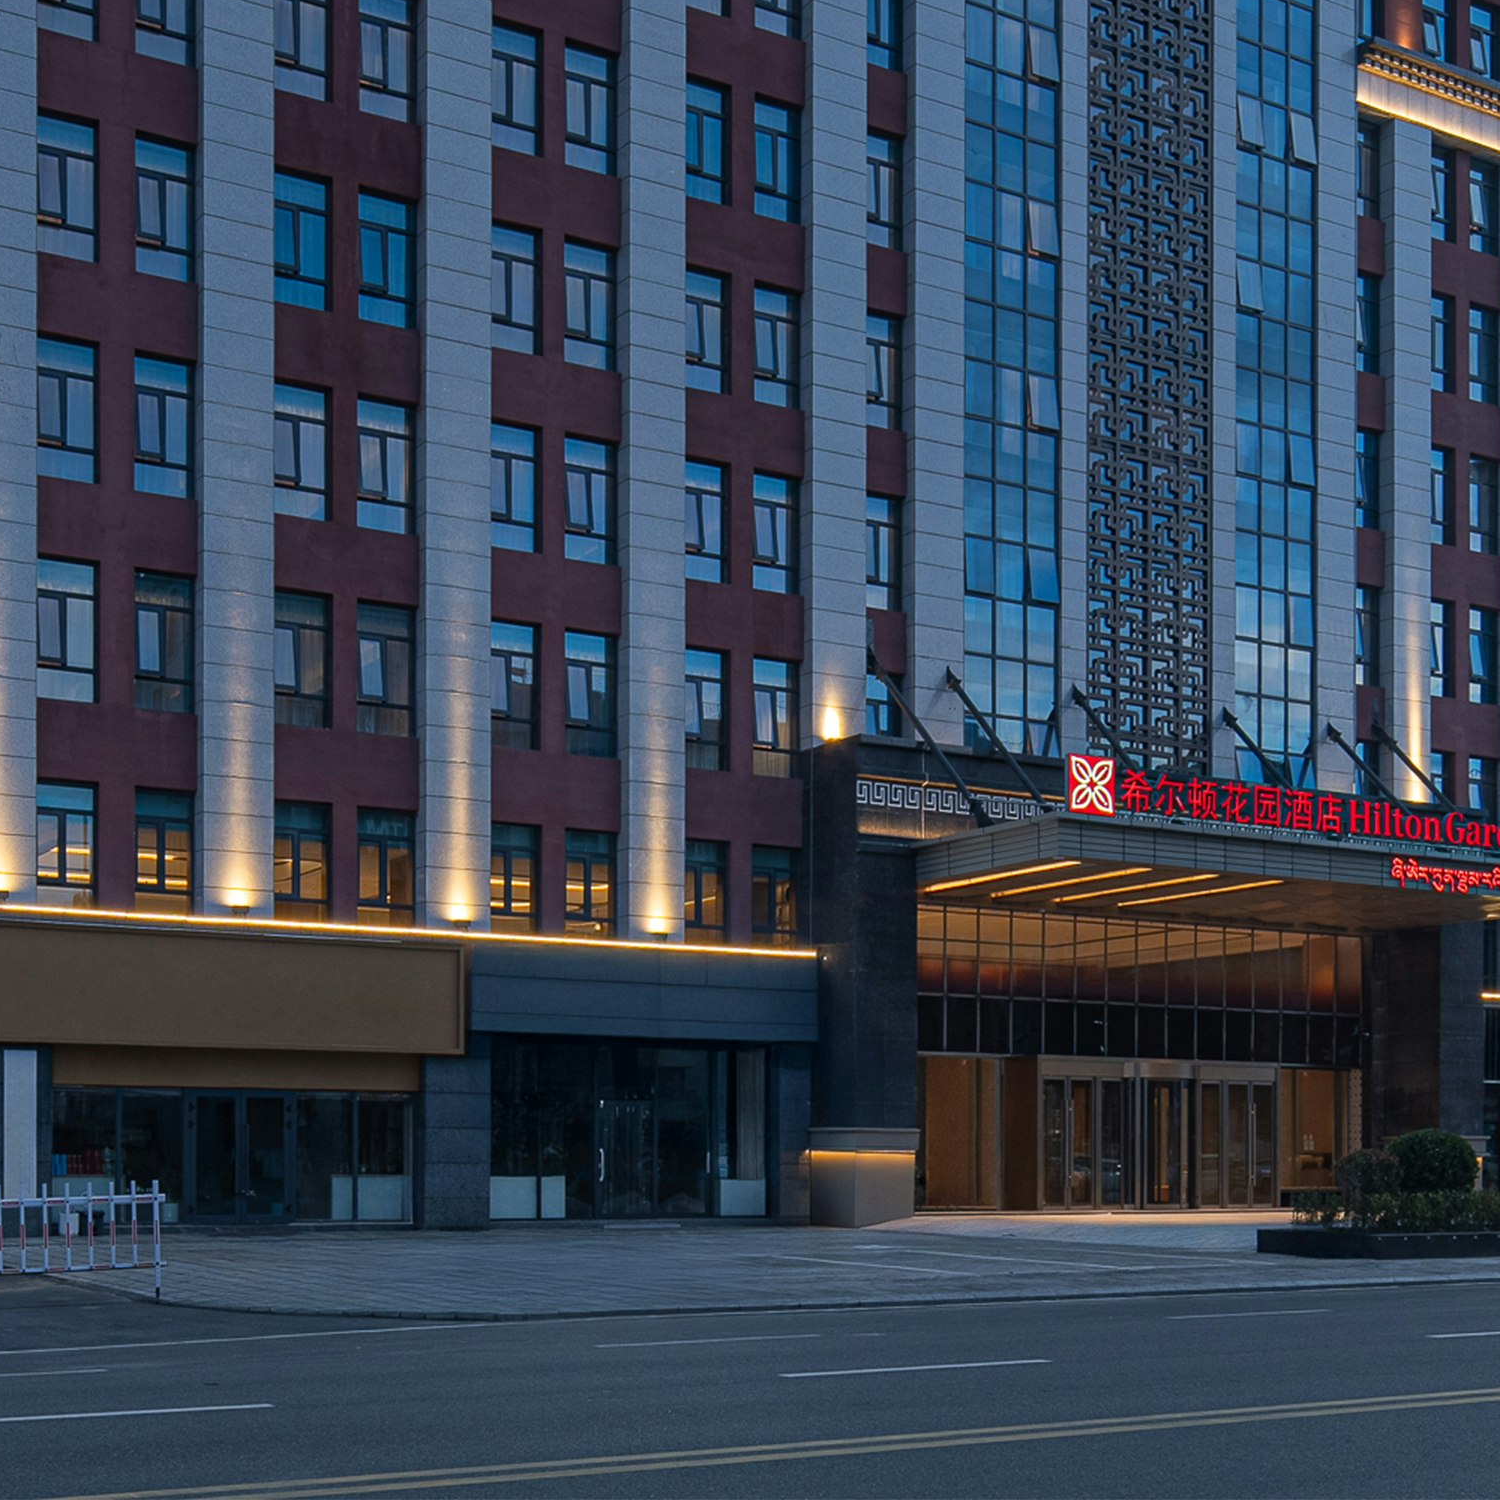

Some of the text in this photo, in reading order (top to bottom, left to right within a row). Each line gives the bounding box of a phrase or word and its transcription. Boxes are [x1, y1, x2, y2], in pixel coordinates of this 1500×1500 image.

[1120, 769, 1343, 833] 希尔顿花园酒店
[1349, 799, 1441, 842] Hilton
